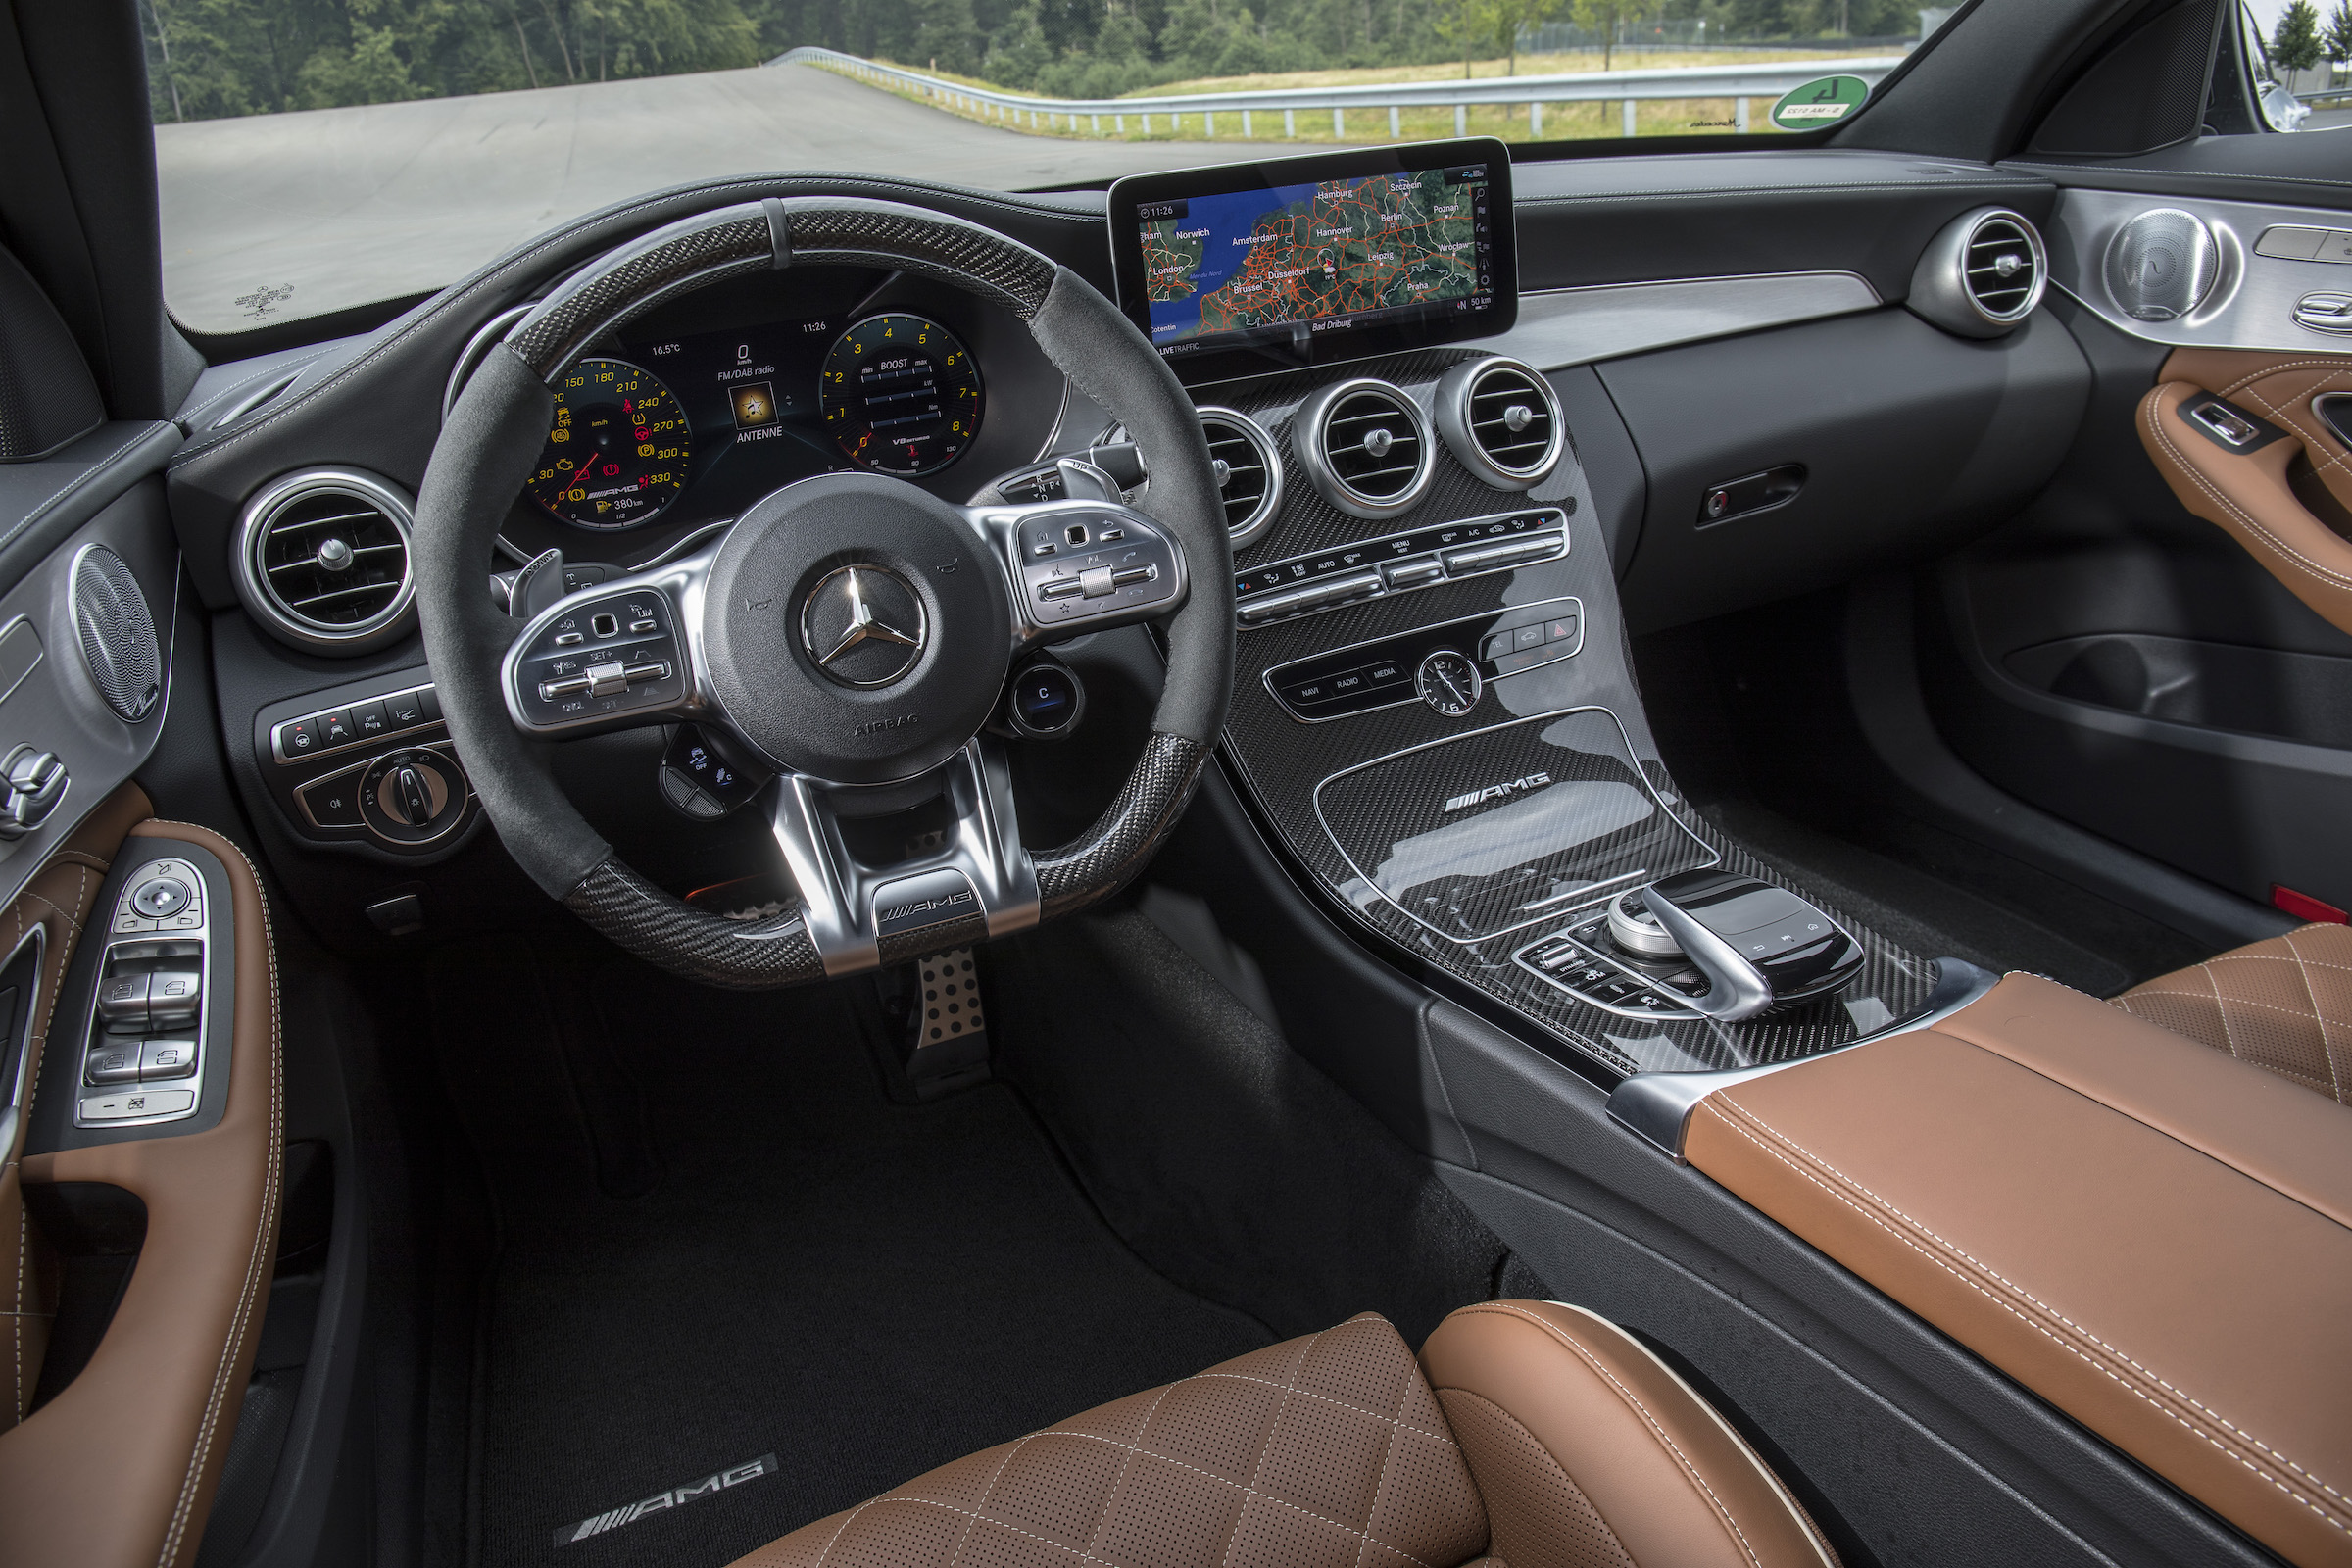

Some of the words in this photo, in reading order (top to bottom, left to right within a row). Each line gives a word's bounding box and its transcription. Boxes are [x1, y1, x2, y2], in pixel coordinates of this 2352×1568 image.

[1390, 181, 1422, 191] Szczecin
[1318, 189, 1353, 199] Hamburg
[1152, 205, 1173, 217] 11:26
[1381, 213, 1402, 221] Berlin
[1176, 227, 1210, 240] Norwich
[1316, 226, 1353, 237] Hannover
[1232, 233, 1278, 246] Amsterdam
[1367, 251, 1395, 262] Leipzig
[1153, 265, 1184, 275] London
[1407, 282, 1429, 291] Praha
[1460, 300, 1467, 310] N
[1471, 297, 1480, 306] 50
[803, 321, 826, 332] 11:26
[1312, 321, 1326, 331] Bad
[1326, 319, 1352, 330] Driburg
[884, 327, 893, 338] 4
[918, 333, 926, 344] 5
[652, 344, 681, 356] 16.5°C
[737, 344, 749, 359] 0
[854, 343, 862, 354] 3
[880, 358, 908, 370] BOOST
[947, 355, 955, 366] 6
[594, 372, 614, 383] 180
[717, 368, 753, 381] FM/DAB
[754, 366, 775, 375] radio
[835, 372, 843, 383] 2
[565, 377, 584, 388] 150
[616, 381, 637, 392] 210
[959, 388, 967, 398] 7
[638, 397, 659, 409] 240
[839, 408, 845, 418] 1
[653, 420, 673, 432] 270
[952, 421, 959, 431] 8
[737, 426, 783, 443] ANTENNE
[658, 448, 678, 459] 300
[1072, 462, 1088, 470] UP
[539, 469, 554, 479] 30
[650, 472, 671, 484] 330
[1039, 484, 1046, 493] N
[1049, 481, 1054, 490] P
[559, 491, 565, 501] 0
[1392, 540, 1410, 549] MENU
[524, 551, 554, 578] DOWN
[1317, 560, 1335, 570] AUTO
[590, 651, 606, 661] SET
[1433, 660, 1446, 670] 12
[1373, 667, 1396, 679] MEDIA
[1337, 677, 1359, 688] RADIO
[1039, 687, 1049, 699] C
[1301, 687, 1319, 697] NAVI
[1449, 703, 1459, 712] 6
[854, 714, 918, 736] AIRBAG
[393, 756, 411, 764] AUTO
